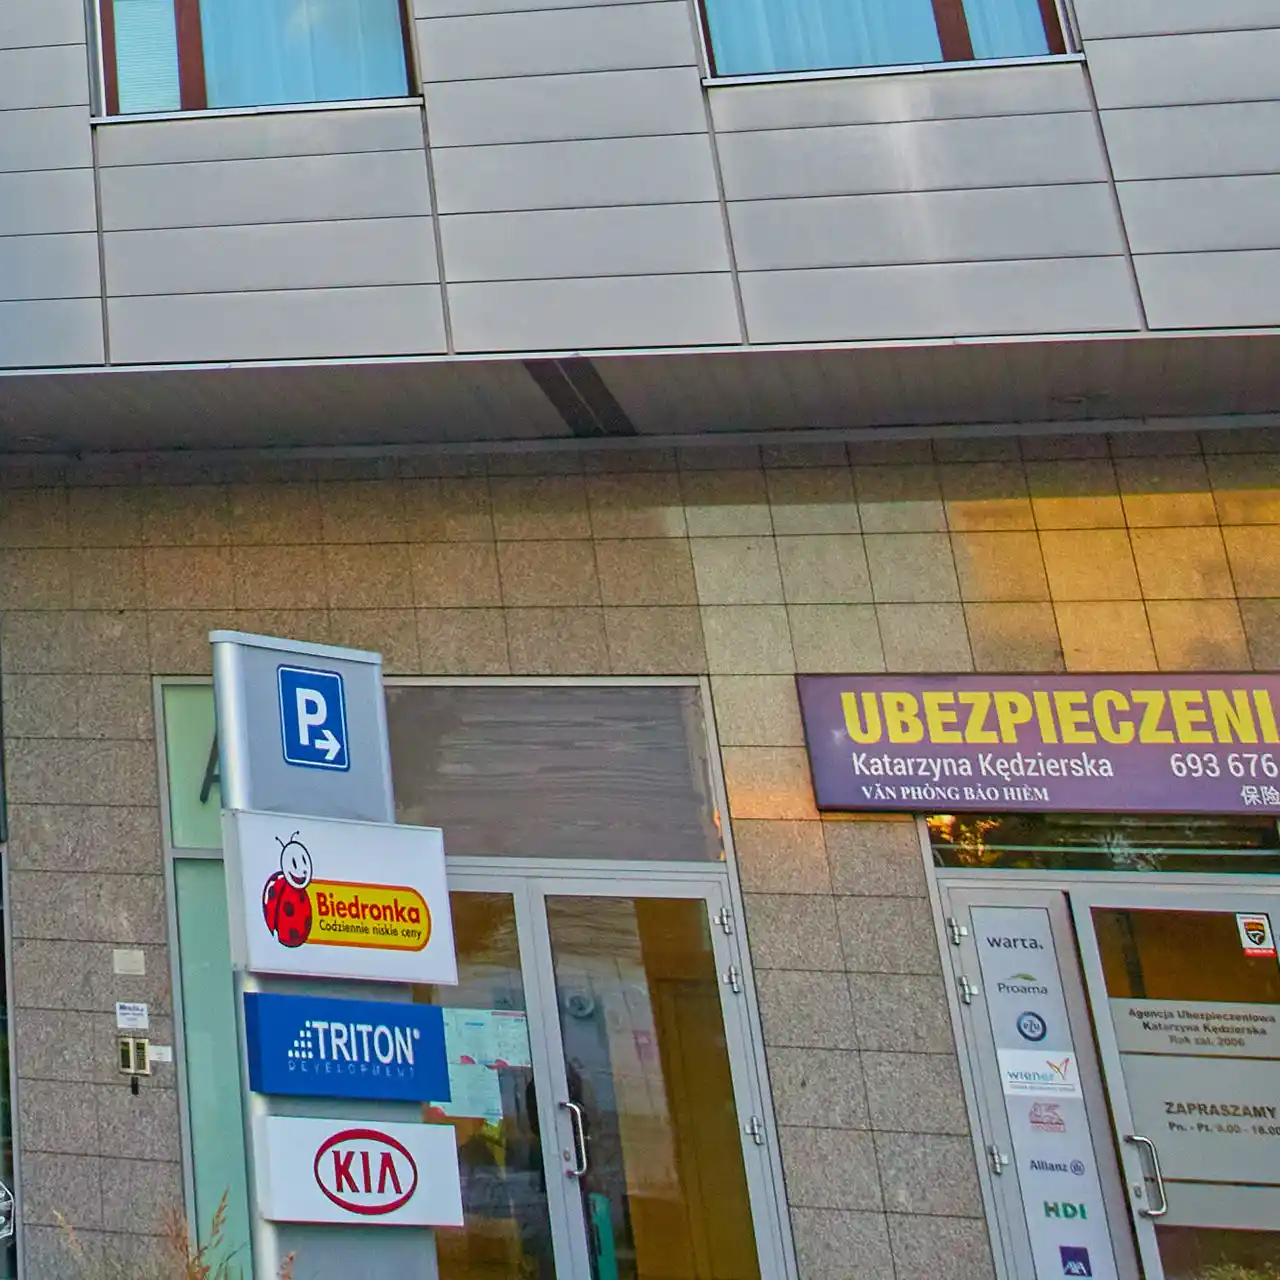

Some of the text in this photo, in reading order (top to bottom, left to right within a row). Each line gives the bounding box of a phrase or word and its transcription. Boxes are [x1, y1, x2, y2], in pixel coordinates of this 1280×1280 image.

[295, 687, 327, 745] P
[841, 689, 1280, 744] UBEZPIECZENI
[852, 752, 1113, 781] Katarzyna Kędzierska
[1170, 753, 1278, 778] 693 676
[316, 892, 421, 924] Biedronka
[319, 919, 422, 940] Codziennie niskie ceny
[997, 982, 1049, 995] Proama
[1164, 1101, 1277, 1119] ZAPRASZAMY
[332, 1150, 402, 1194] KIA
[1030, 1160, 1068, 1173] Allianz
[1043, 1200, 1087, 1220] HDI
